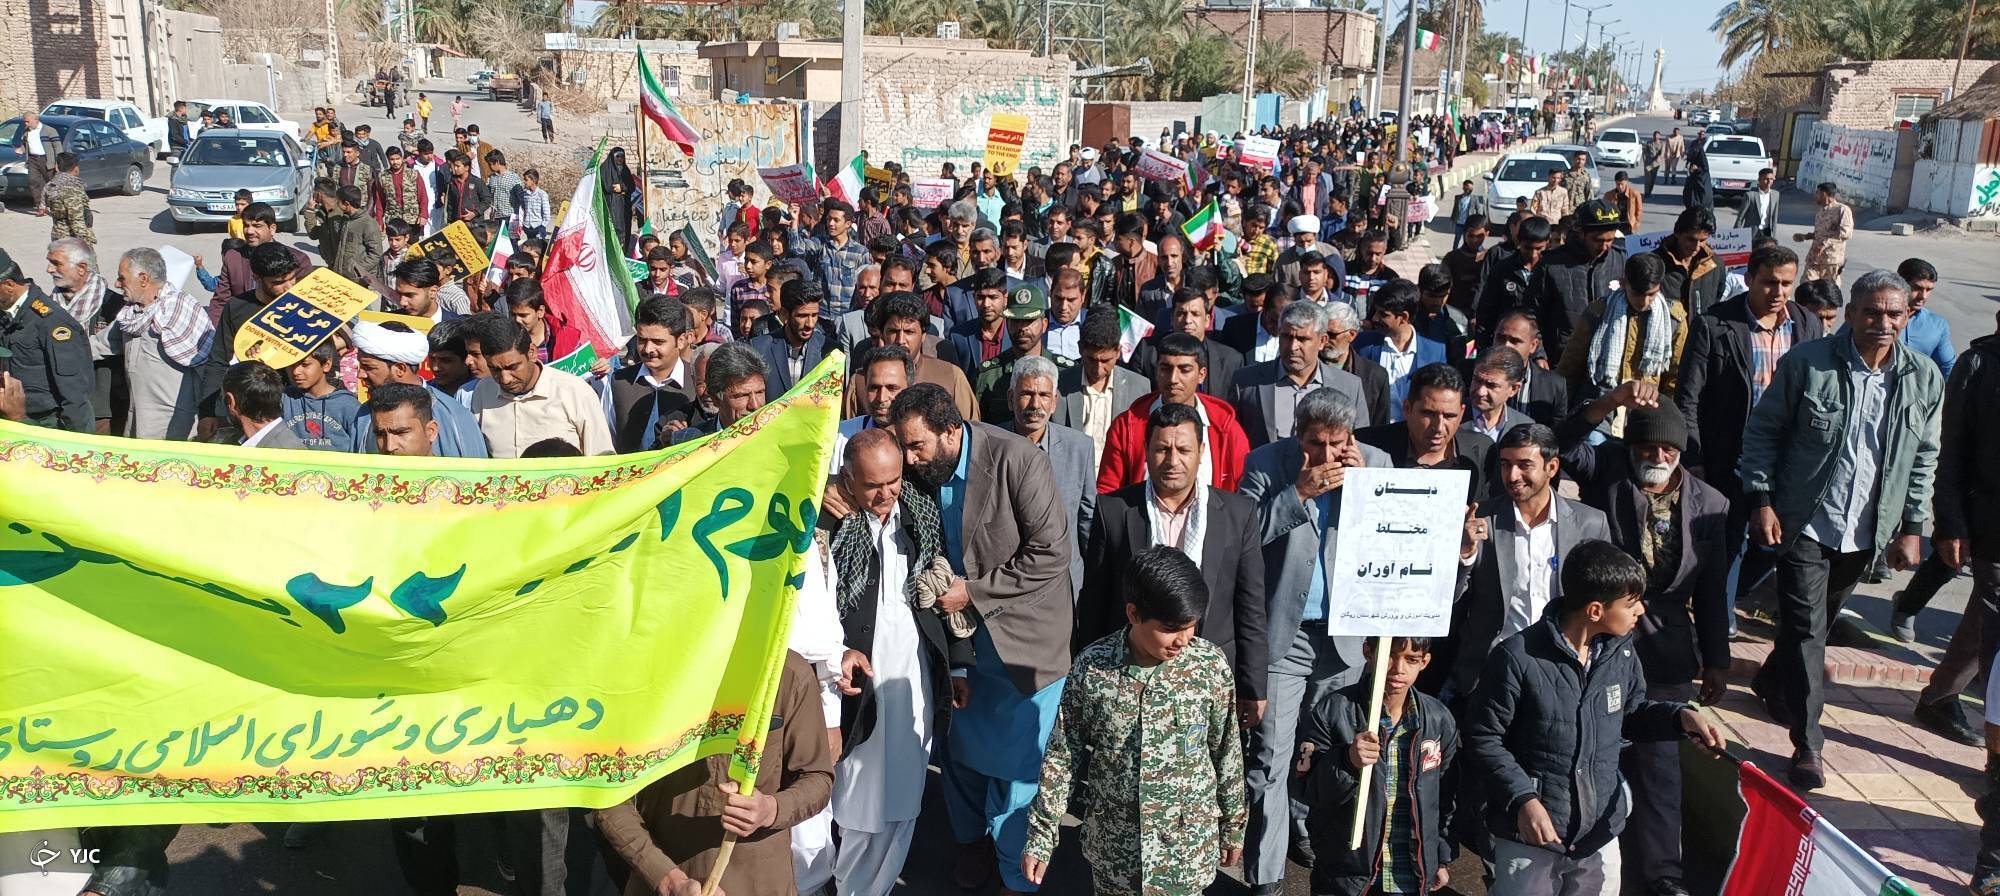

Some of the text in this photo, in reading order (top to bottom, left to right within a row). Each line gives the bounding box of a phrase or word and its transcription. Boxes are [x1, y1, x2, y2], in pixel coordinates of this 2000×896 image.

[276, 301, 331, 329] مرگ بر
[244, 325, 265, 339] DOWN
[265, 334, 283, 349] WITH
[1374, 481, 1438, 499] دبستان
[1375, 522, 1428, 535] مختلط
[1399, 562, 1433, 579] نام
[254, 692, 403, 767] شورای
[391, 721, 421, 750] و
[425, 695, 605, 754] دهیاری
[124, 713, 258, 773] اسلامی
